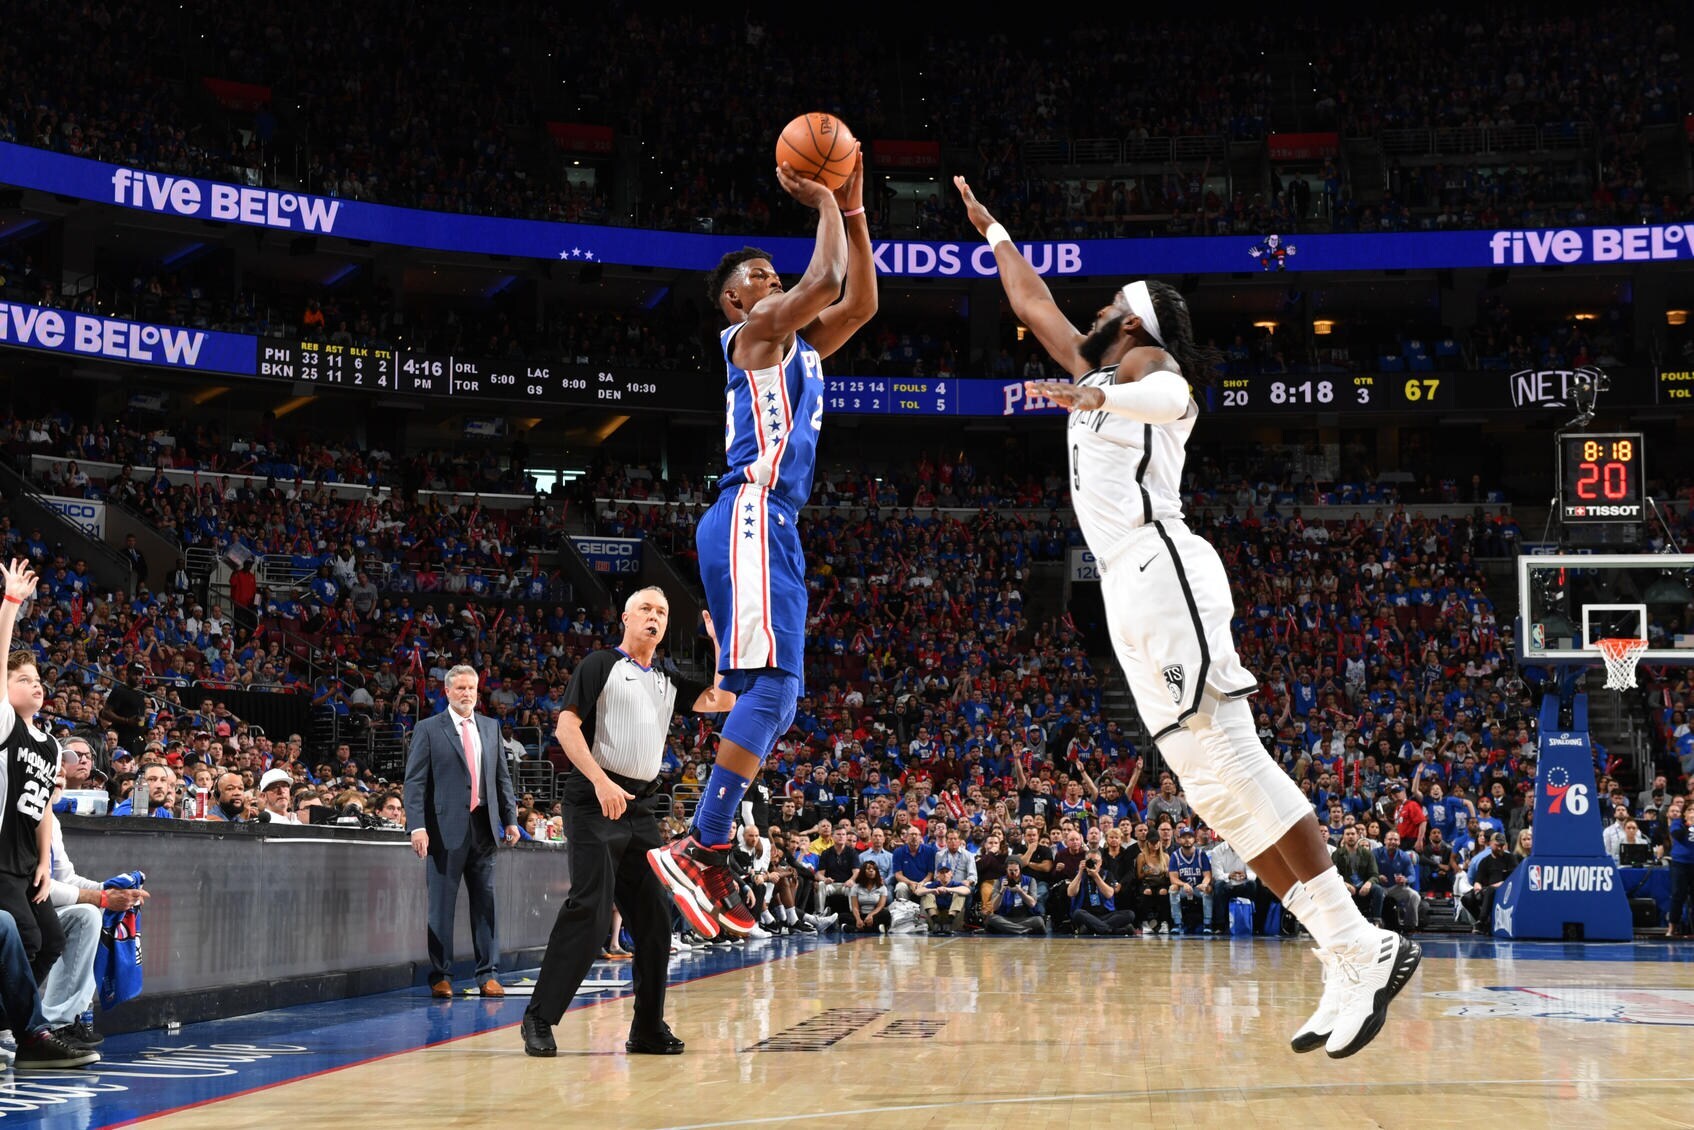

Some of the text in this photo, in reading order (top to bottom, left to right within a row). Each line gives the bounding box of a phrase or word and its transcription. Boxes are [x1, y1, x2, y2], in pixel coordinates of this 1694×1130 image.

[112, 168, 340, 232] five BELOW
[1490, 225, 1694, 264] five BELO
[871, 243, 1083, 276] KIDS CUB
[0, 303, 205, 365] ive BELOW
[301, 342, 391, 359] REB AST BLK STL
[265, 347, 387, 372] PHI 33 11 6 2
[403, 358, 443, 377] 4:16
[455, 363, 478, 374] ORL
[527, 368, 550, 379] LAC
[261, 362, 387, 387] BKN 25 11 2 4
[598, 372, 614, 383] SA
[414, 379, 432, 389] PM
[454, 380, 479, 391] TOR
[562, 379, 586, 389] 8:00
[830, 382, 885, 392] 21 25 14
[1223, 379, 1249, 388] SHOT
[1354, 377, 1373, 385] QTR
[527, 385, 543, 395] GS
[626, 383, 656, 393] 10:30
[893, 382, 946, 394] FOULS 4
[1270, 380, 1334, 404] 8:18
[1404, 379, 1440, 400] 67
[1669, 389, 1691, 398] TOL
[598, 389, 621, 400] DEN
[1223, 390, 1249, 406] 20
[1357, 388, 1370, 404] 3
[830, 398, 880, 409] 15 3 2
[900, 399, 945, 411] TOL 5
[1584, 441, 1632, 461] 8:18
[1577, 463, 1627, 499] 20
[1586, 506, 1640, 516] TISSOT
[577, 543, 633, 555] GEICO
[616, 559, 639, 572] 120
[1549, 737, 1583, 746] SPALDING
[17, 780, 50, 821] 25
[1546, 783, 1589, 815] 76
[1543, 866, 1613, 892] PLAYOFFS
